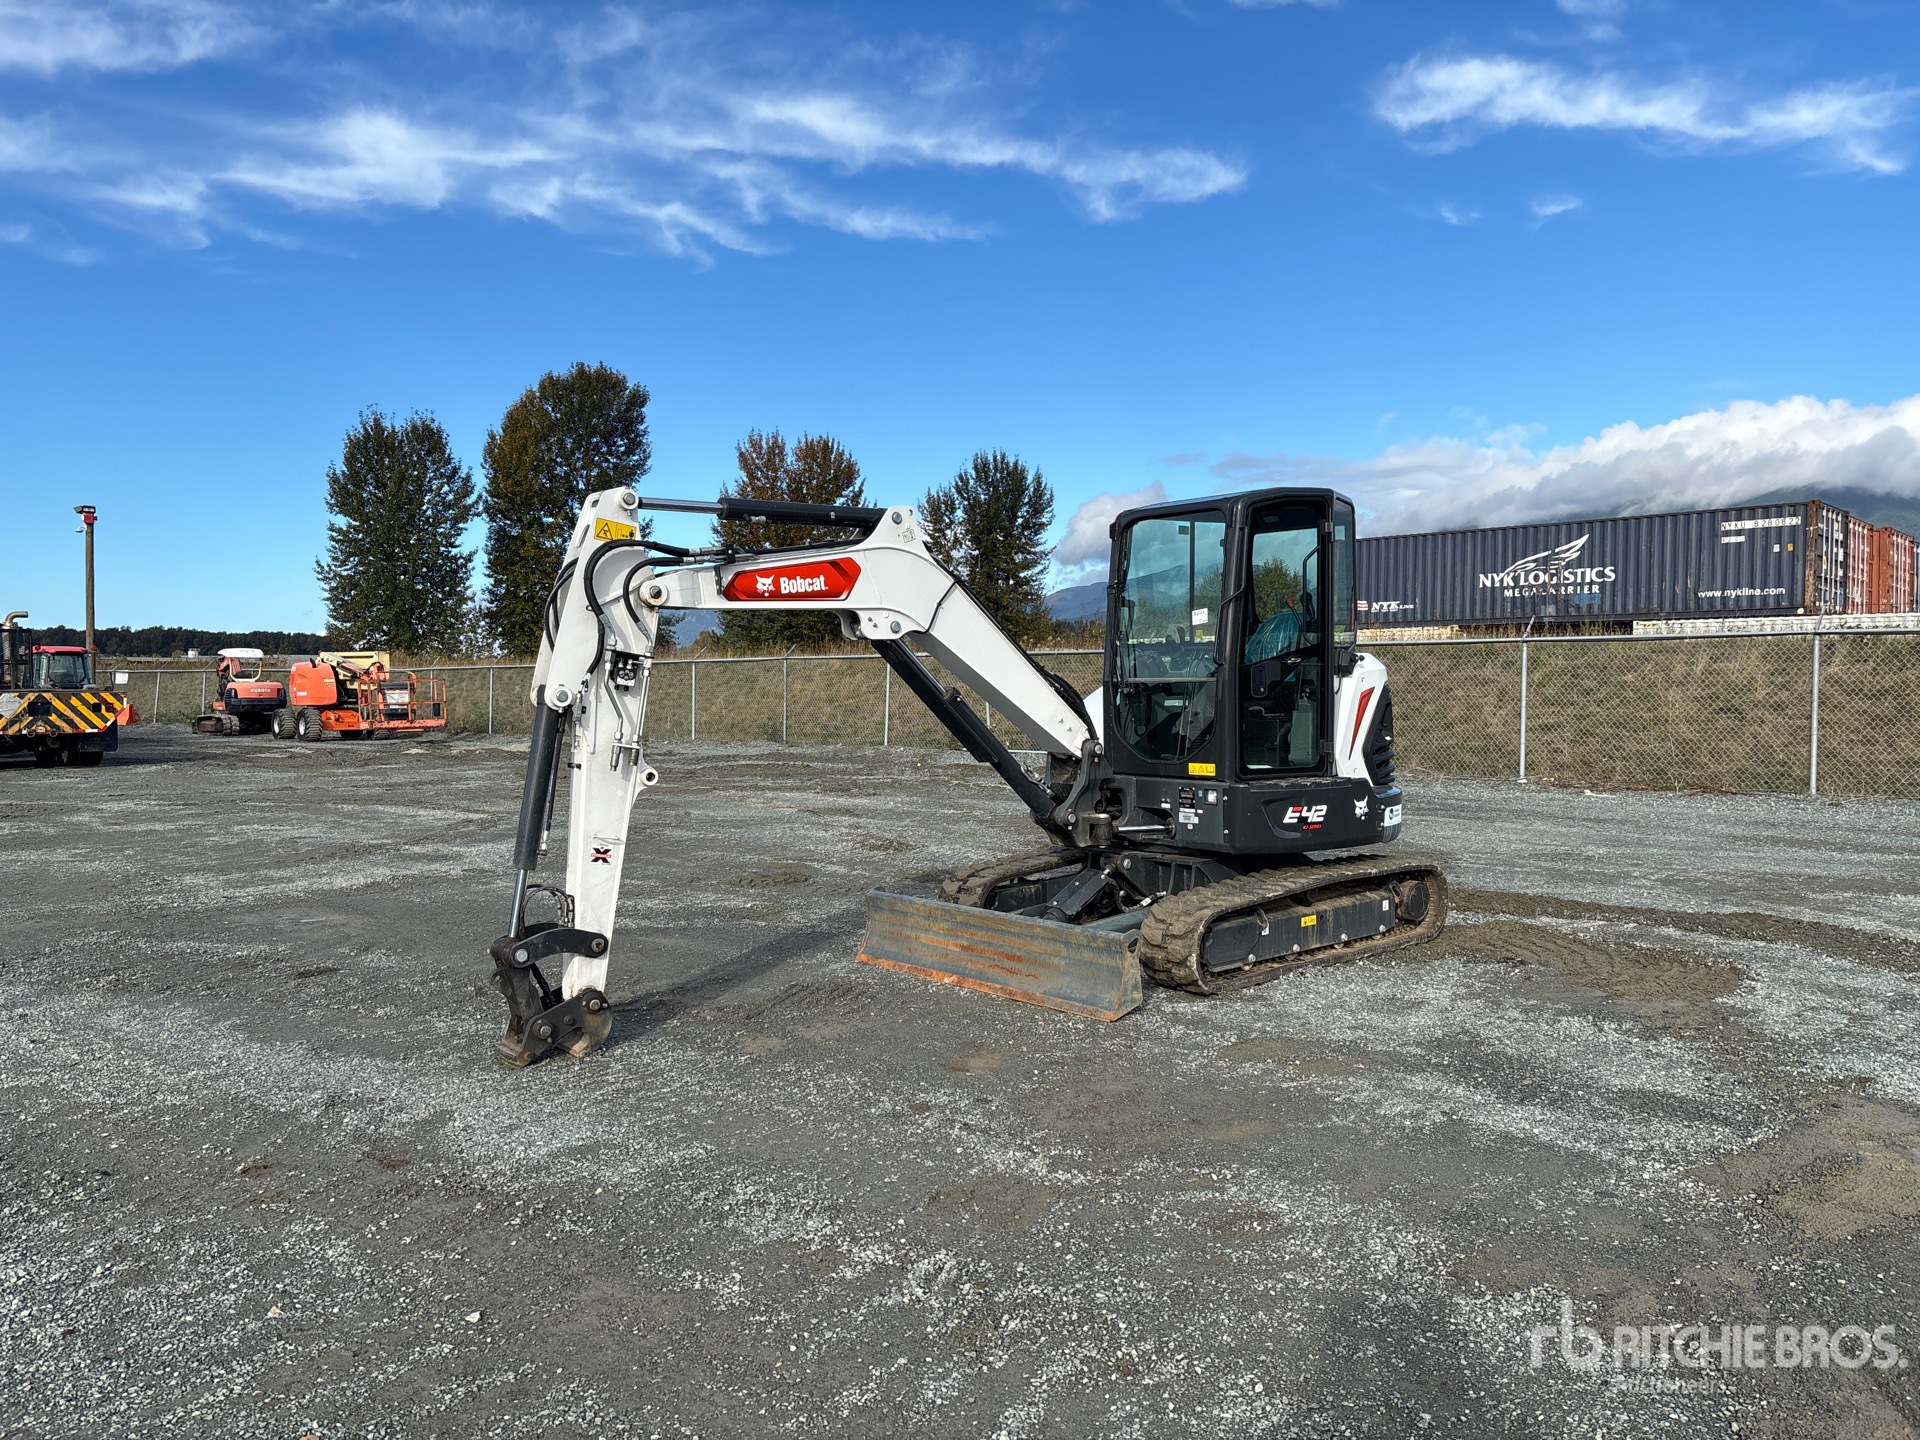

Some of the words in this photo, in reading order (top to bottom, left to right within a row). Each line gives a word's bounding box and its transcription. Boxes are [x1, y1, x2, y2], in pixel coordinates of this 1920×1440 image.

[1721, 521, 1746, 530] NYKU
[1753, 517, 1801, 527] 8280822
[779, 574, 826, 594] Bobcat
[1479, 571, 1515, 588] NYK
[1520, 566, 1616, 586] LOGISTICS
[1697, 587, 1786, 598] www.nykline.com
[1371, 601, 1400, 610] NYK
[1282, 804, 1328, 823] E42
